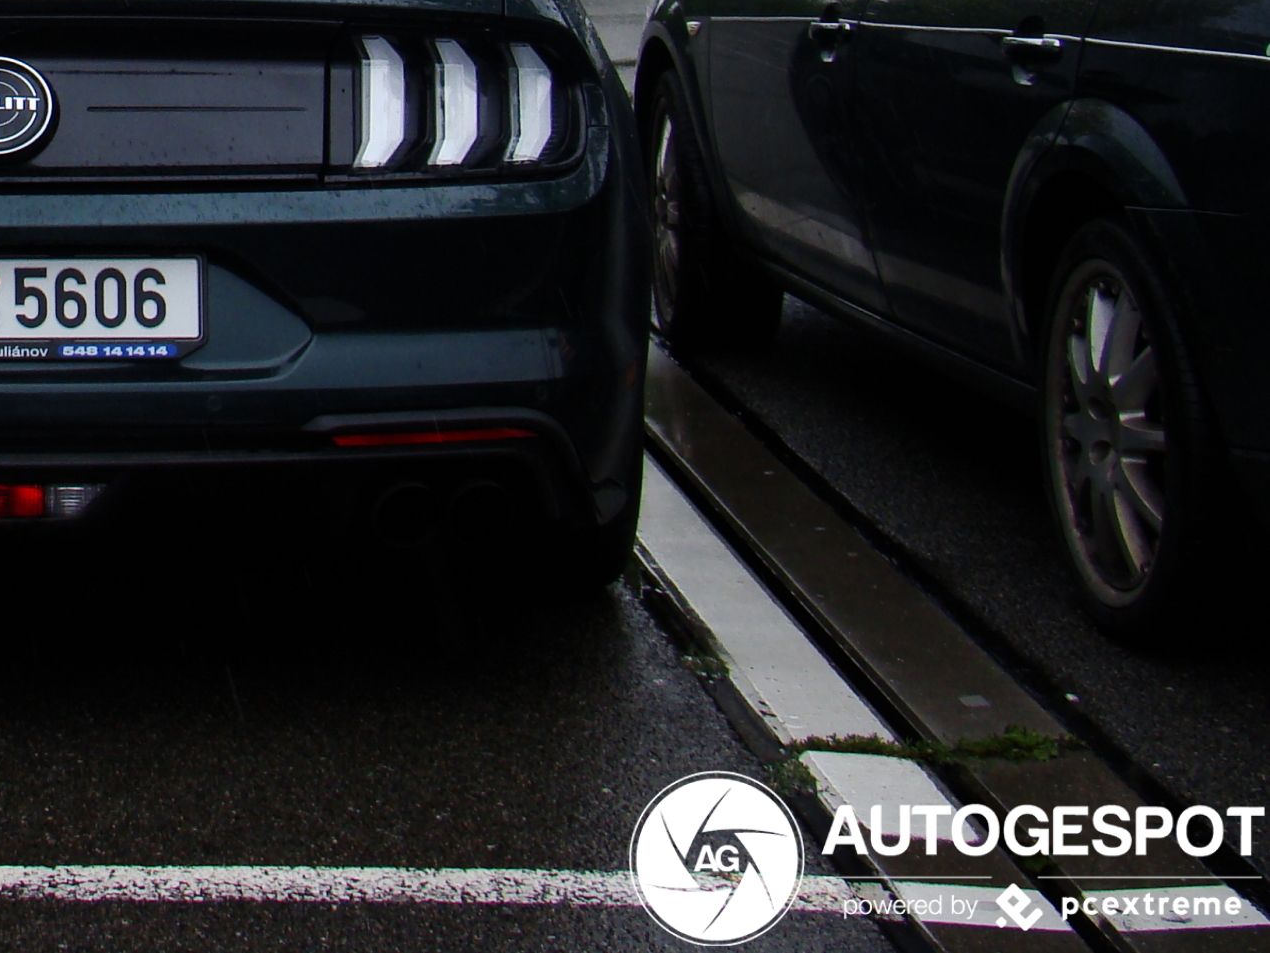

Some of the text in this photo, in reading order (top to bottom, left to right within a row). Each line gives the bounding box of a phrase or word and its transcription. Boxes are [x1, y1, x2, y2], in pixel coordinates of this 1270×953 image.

[13, 266, 167, 329] 5606
[62, 345, 99, 357] 548
[103, 346, 124, 357] 14
[125, 345, 146, 357] 14
[147, 345, 169, 357] 14
